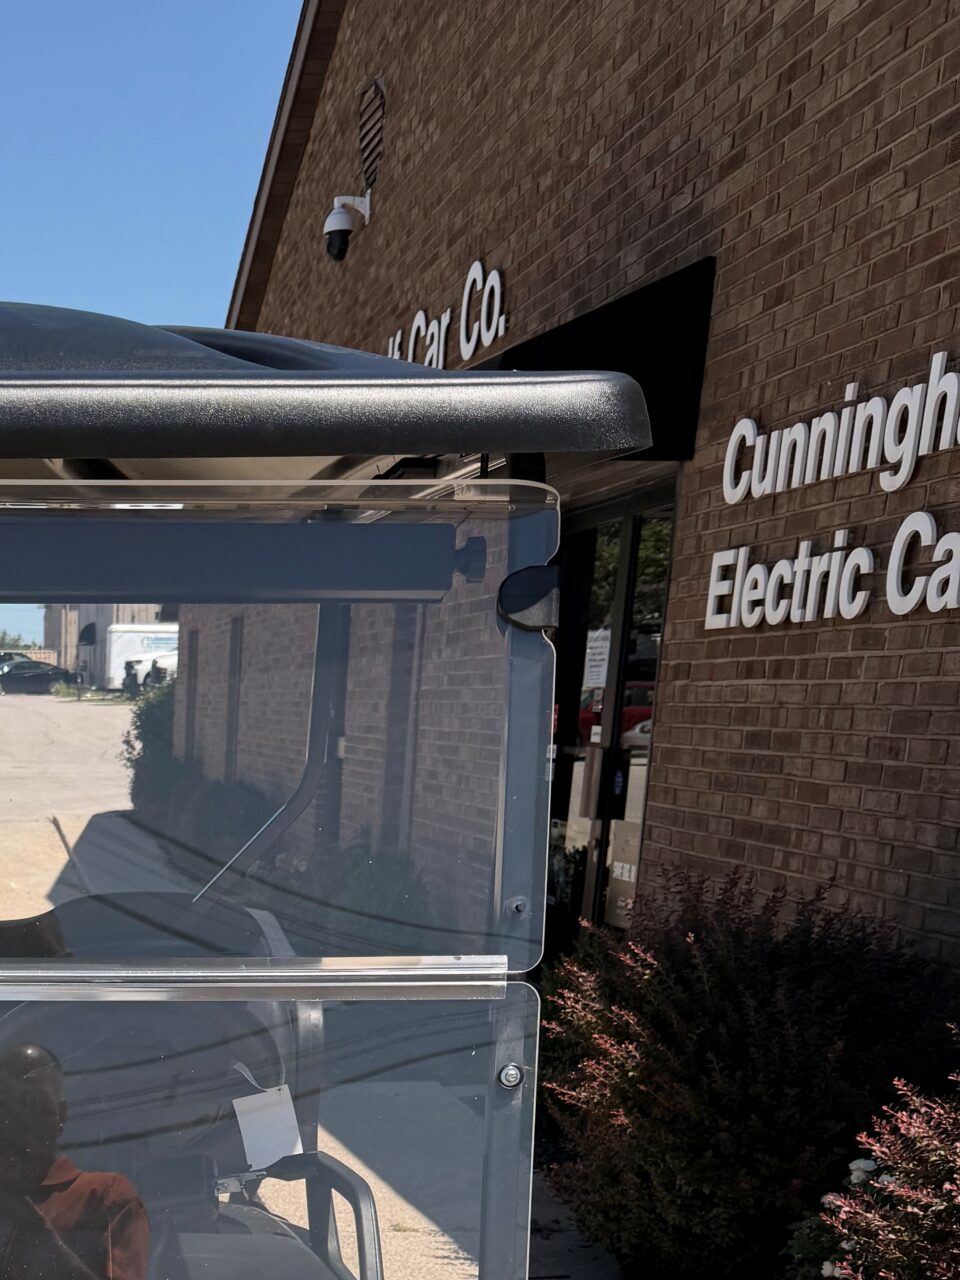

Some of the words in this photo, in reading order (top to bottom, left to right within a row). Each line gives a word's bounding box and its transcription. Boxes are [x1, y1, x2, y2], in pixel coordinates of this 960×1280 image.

[407, 307, 451, 370] Car
[460, 260, 506, 361] Co.
[723, 351, 960, 504] Cunningh
[704, 529, 874, 630] Electric
